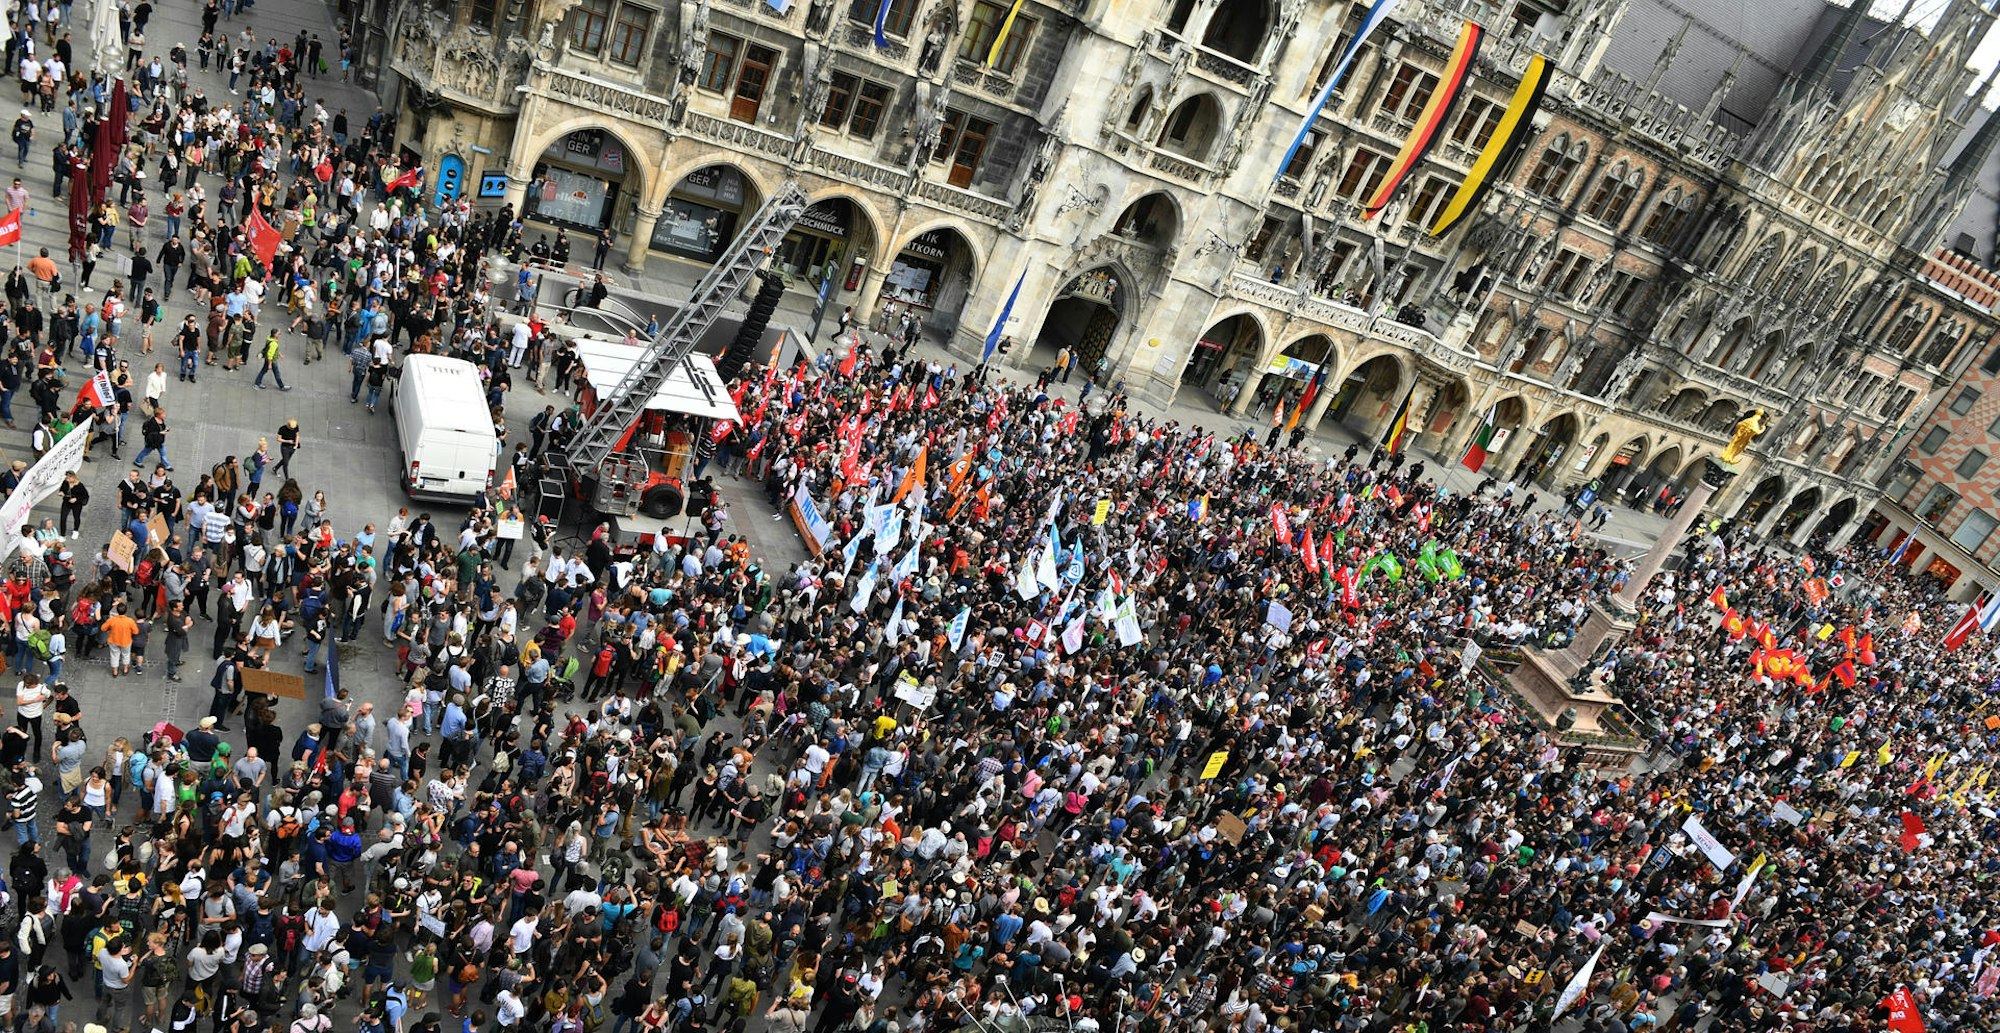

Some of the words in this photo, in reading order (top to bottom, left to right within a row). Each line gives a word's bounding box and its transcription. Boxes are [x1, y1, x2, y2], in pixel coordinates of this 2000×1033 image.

[567, 139, 591, 155] GER
[688, 172, 711, 186] GER
[798, 216, 845, 237] RSCHMUCK
[918, 232, 940, 245] TIK
[904, 240, 945, 258] RTKORN
[826, 265, 834, 280] S
[820, 280, 829, 296] U
[1589, 480, 1600, 492] S
[1582, 490, 1592, 501] U
